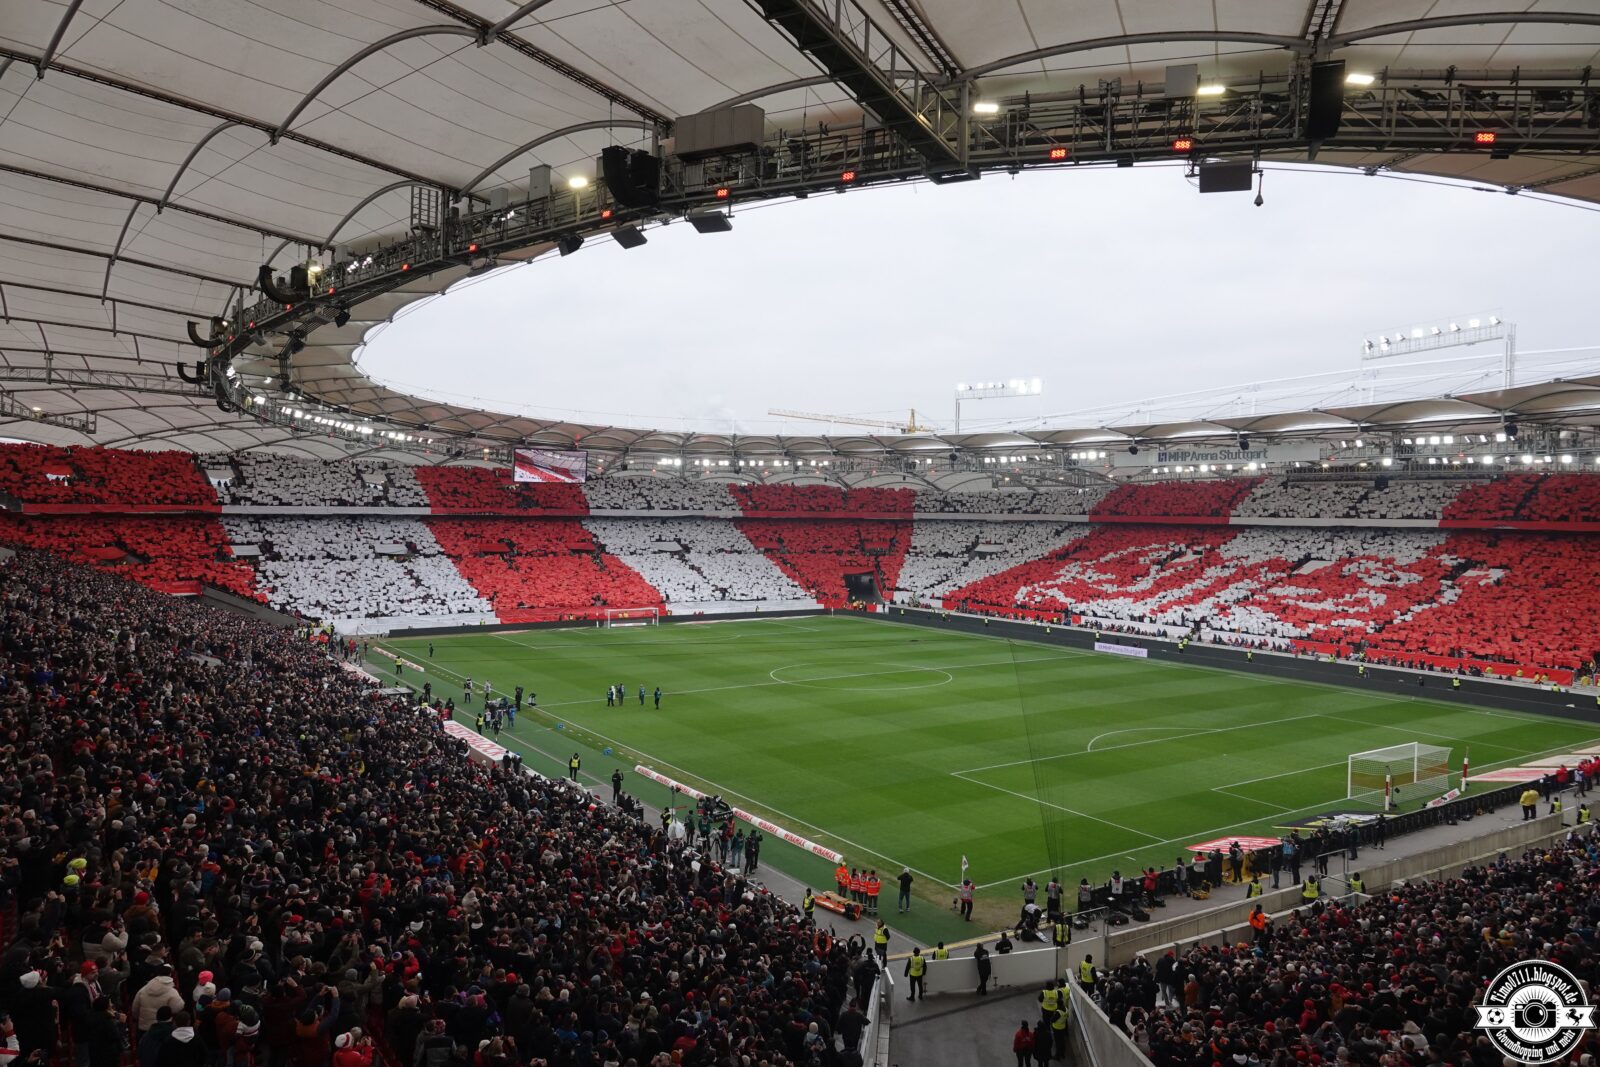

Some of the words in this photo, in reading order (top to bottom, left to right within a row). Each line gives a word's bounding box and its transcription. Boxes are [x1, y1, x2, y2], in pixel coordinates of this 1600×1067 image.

[1219, 448, 1269, 461] Stuttgart
[783, 833, 806, 848] WINAMAX
[812, 846, 836, 861] WINAMAX
